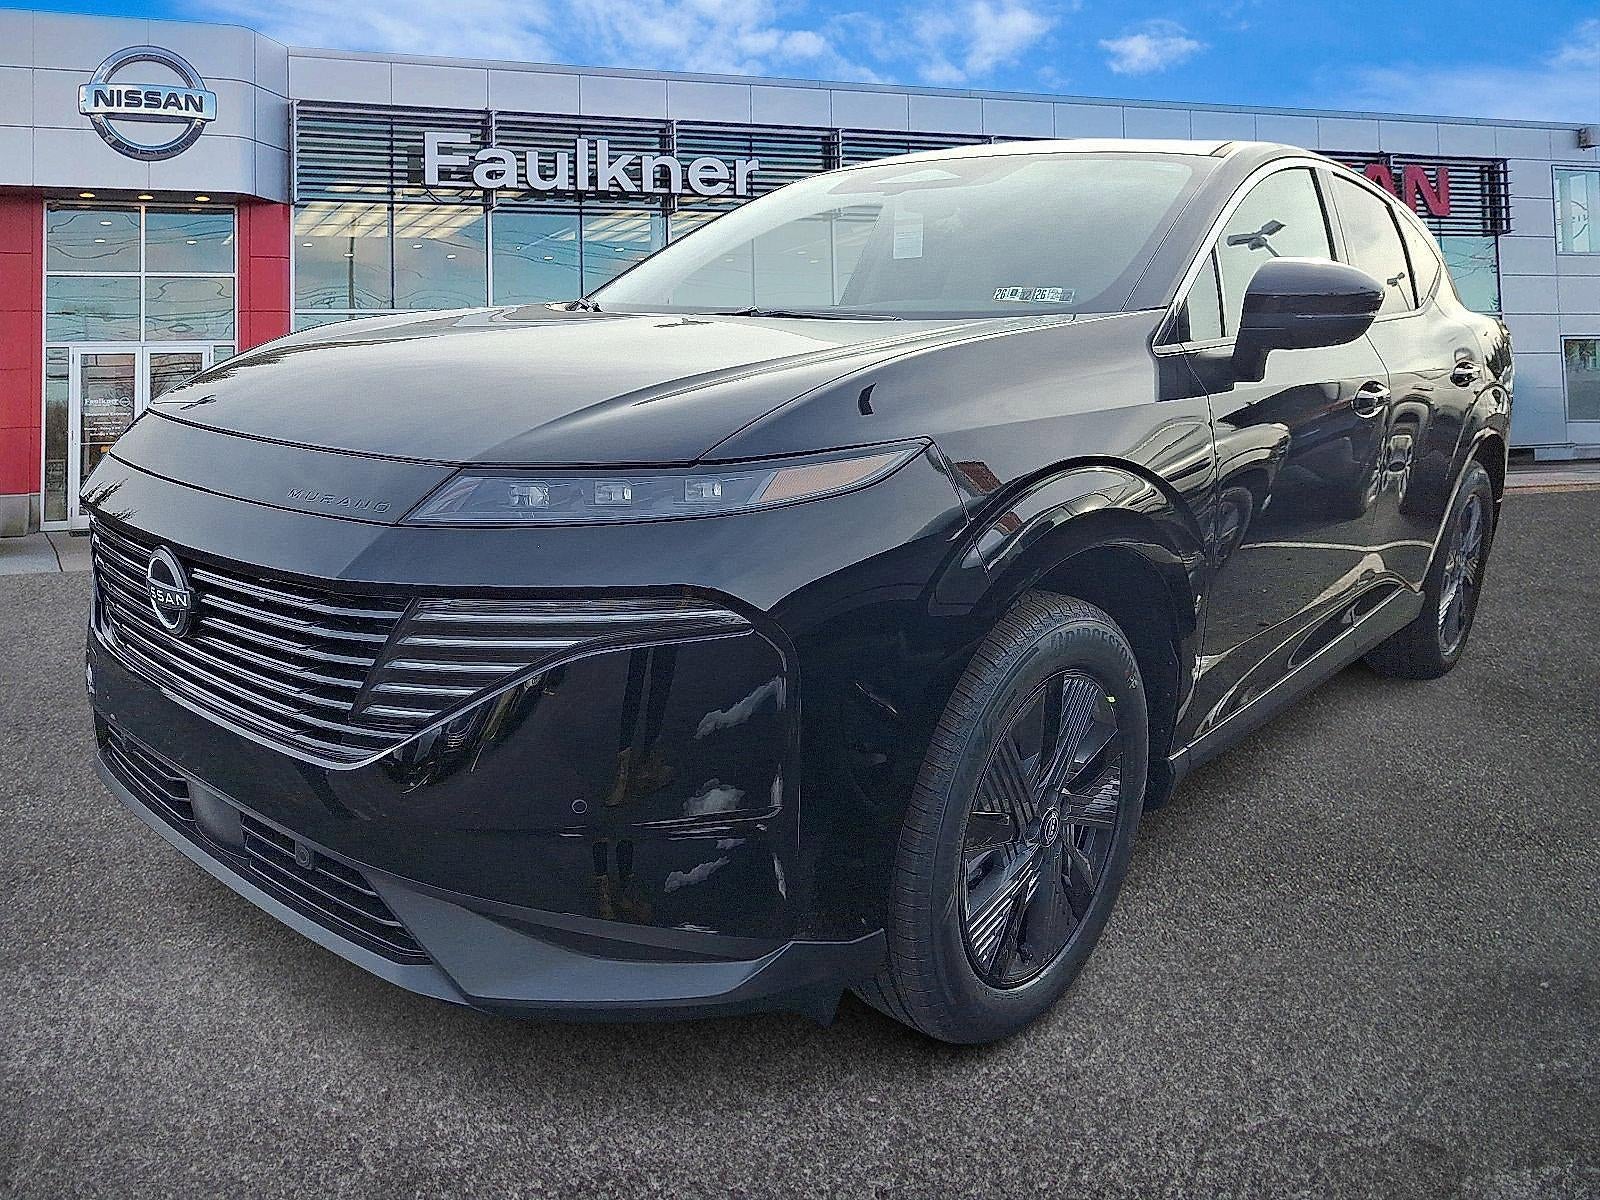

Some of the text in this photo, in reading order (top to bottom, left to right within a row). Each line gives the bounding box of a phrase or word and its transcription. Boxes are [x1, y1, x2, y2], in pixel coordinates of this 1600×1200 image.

[94, 89, 204, 113] NISSAN
[423, 131, 760, 197] Faulkner
[287, 487, 392, 513] MURANO
